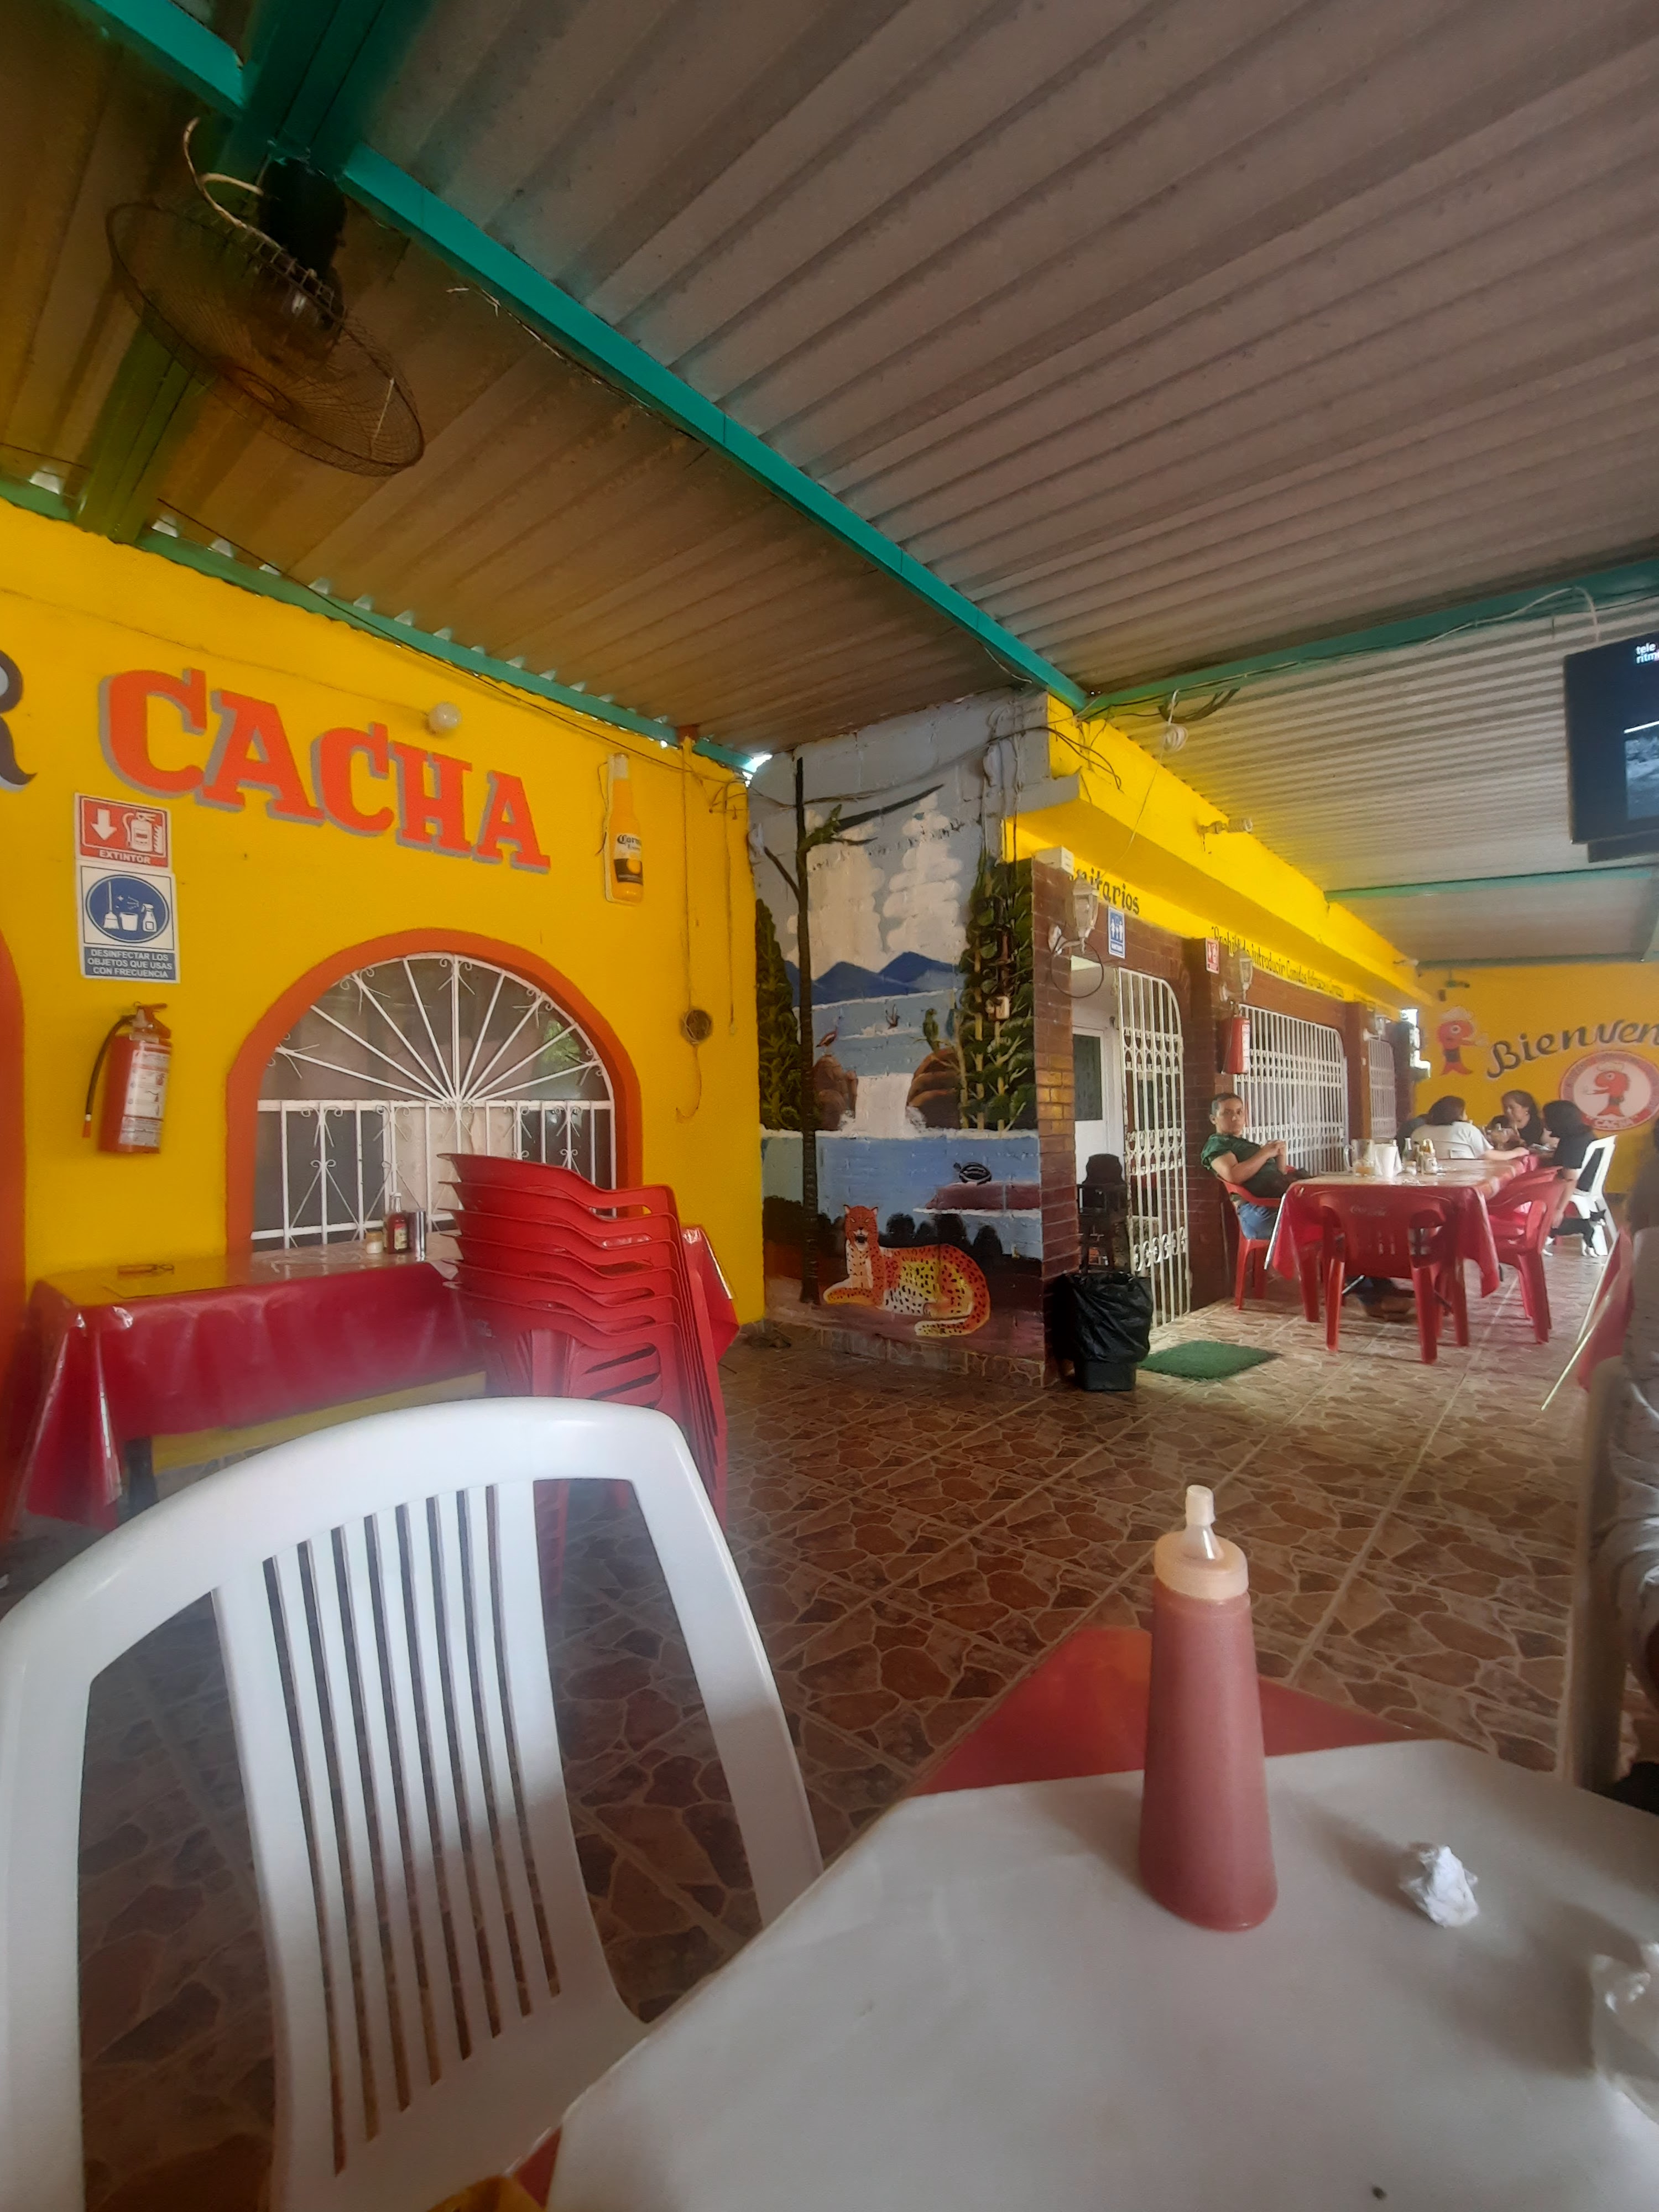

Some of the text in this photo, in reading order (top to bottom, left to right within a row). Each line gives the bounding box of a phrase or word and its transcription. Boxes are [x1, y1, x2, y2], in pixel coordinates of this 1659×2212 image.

[1636, 643, 1656, 655] tele
[98, 667, 551, 874] CACHA
[99, 850, 151, 864] EXTINTOR
[91, 949, 150, 961] DESINFECTAR
[87, 958, 128, 967] OBJETOS
[114, 968, 169, 978] FRECUENCIA
